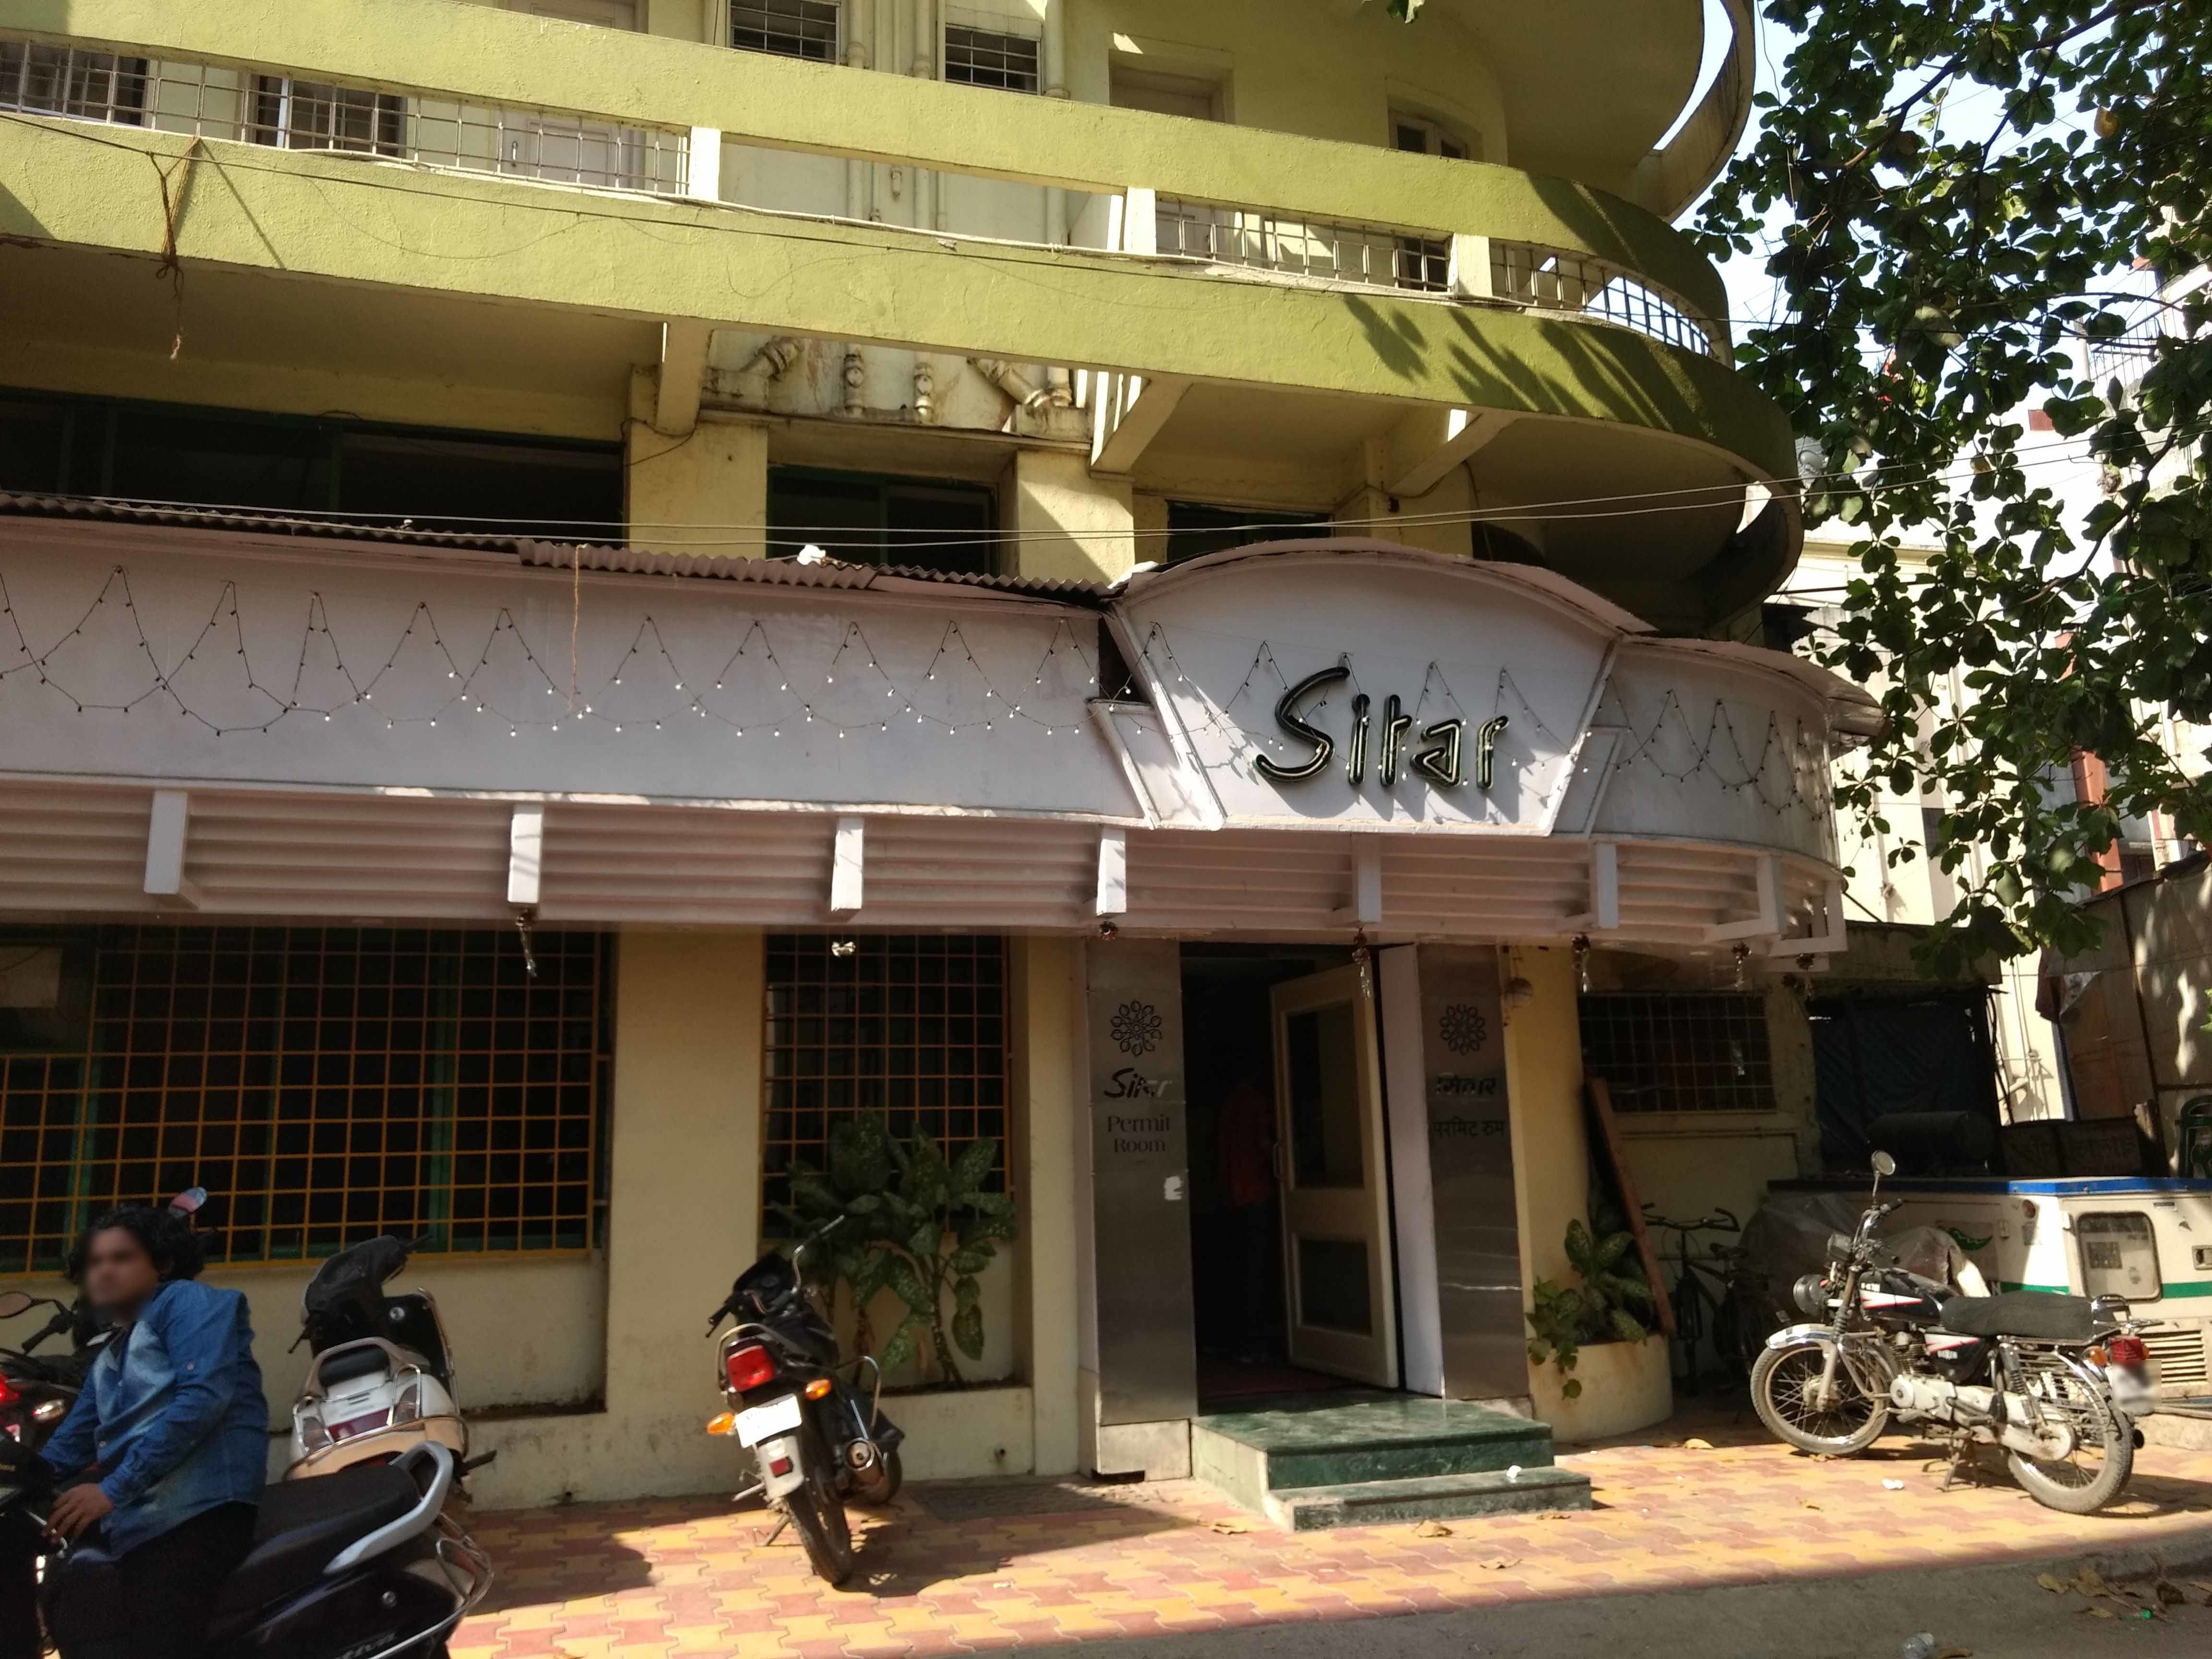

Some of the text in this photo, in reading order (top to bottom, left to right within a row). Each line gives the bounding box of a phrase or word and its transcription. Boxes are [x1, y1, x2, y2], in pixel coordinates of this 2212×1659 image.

[1252, 666, 1509, 789] Sitar
[1104, 1068, 1173, 1098] Sitar
[1108, 1114, 1171, 1132] Permit
[1432, 1116, 1479, 1138] परमिट
[1115, 1138, 1166, 1152] Room
